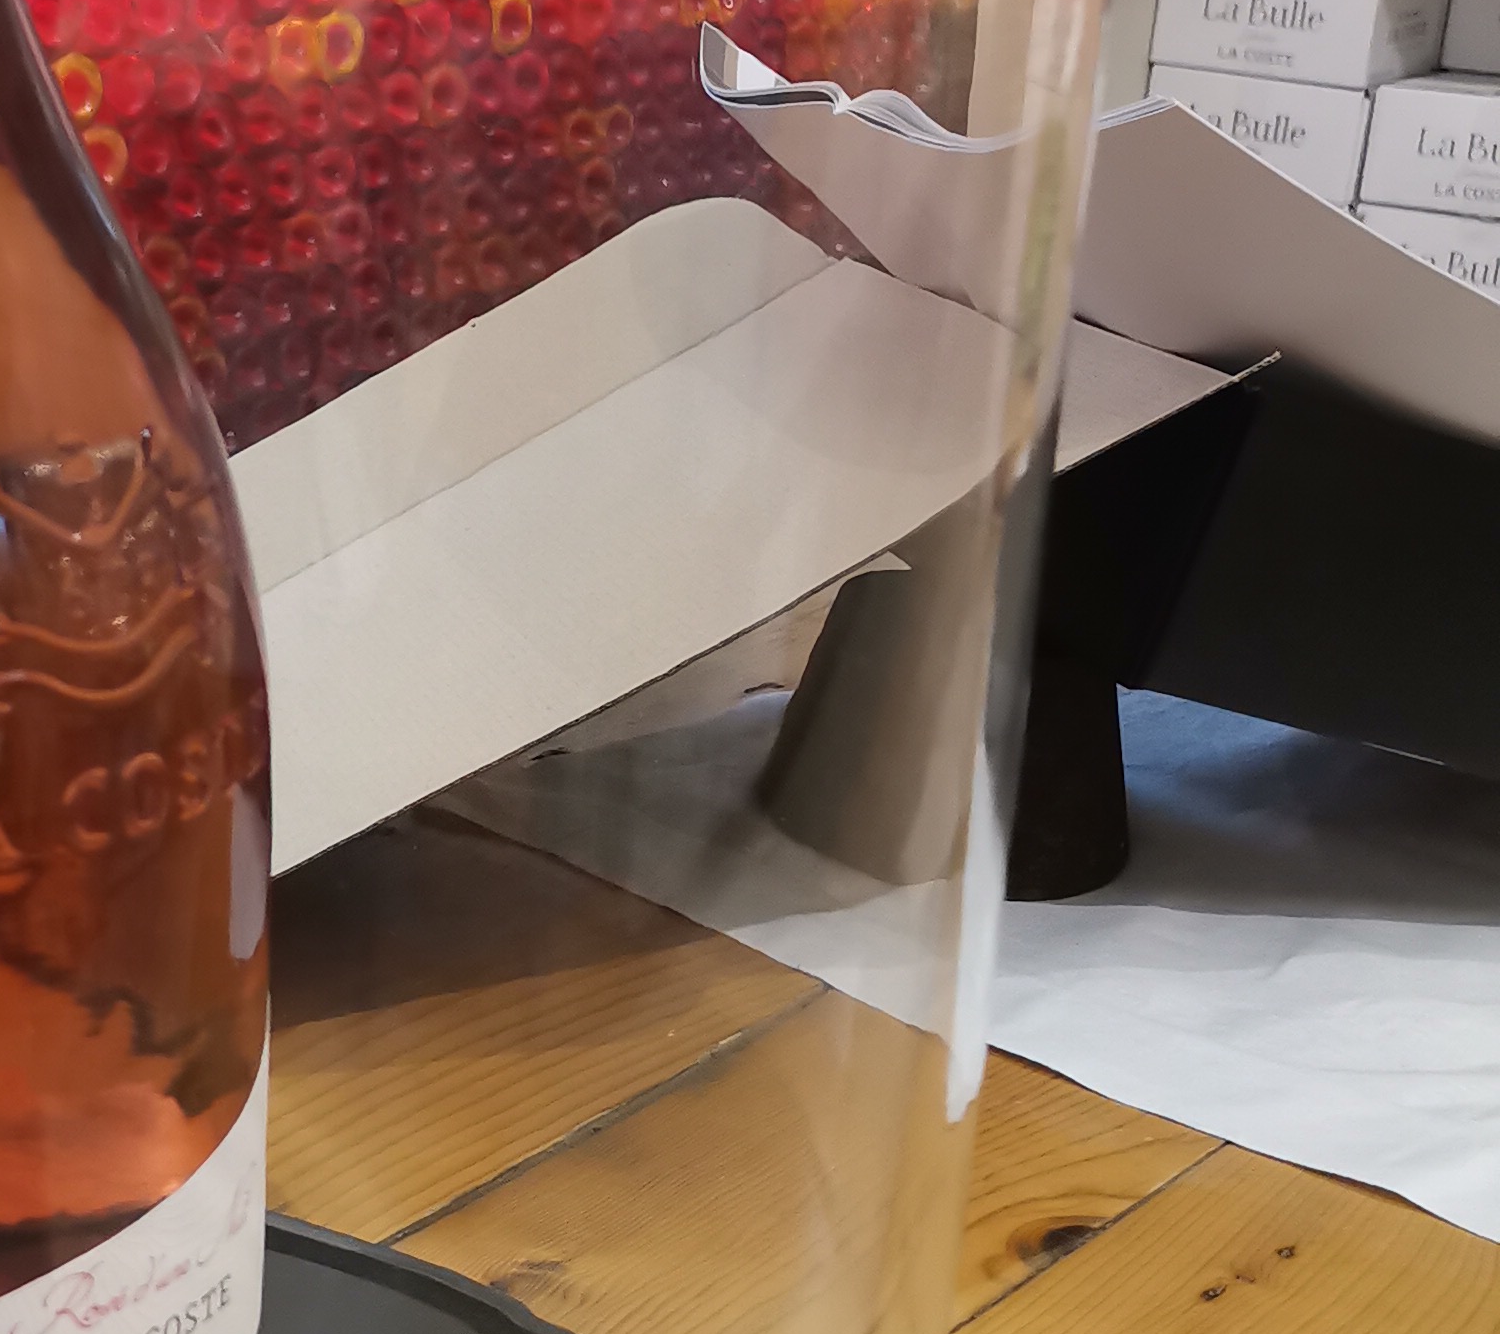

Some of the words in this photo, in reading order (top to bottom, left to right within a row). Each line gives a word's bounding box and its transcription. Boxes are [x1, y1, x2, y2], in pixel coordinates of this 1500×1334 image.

[1231, 110, 1307, 146] Bulle
[1417, 127, 1456, 158] La
[1434, 181, 1456, 198] LA
